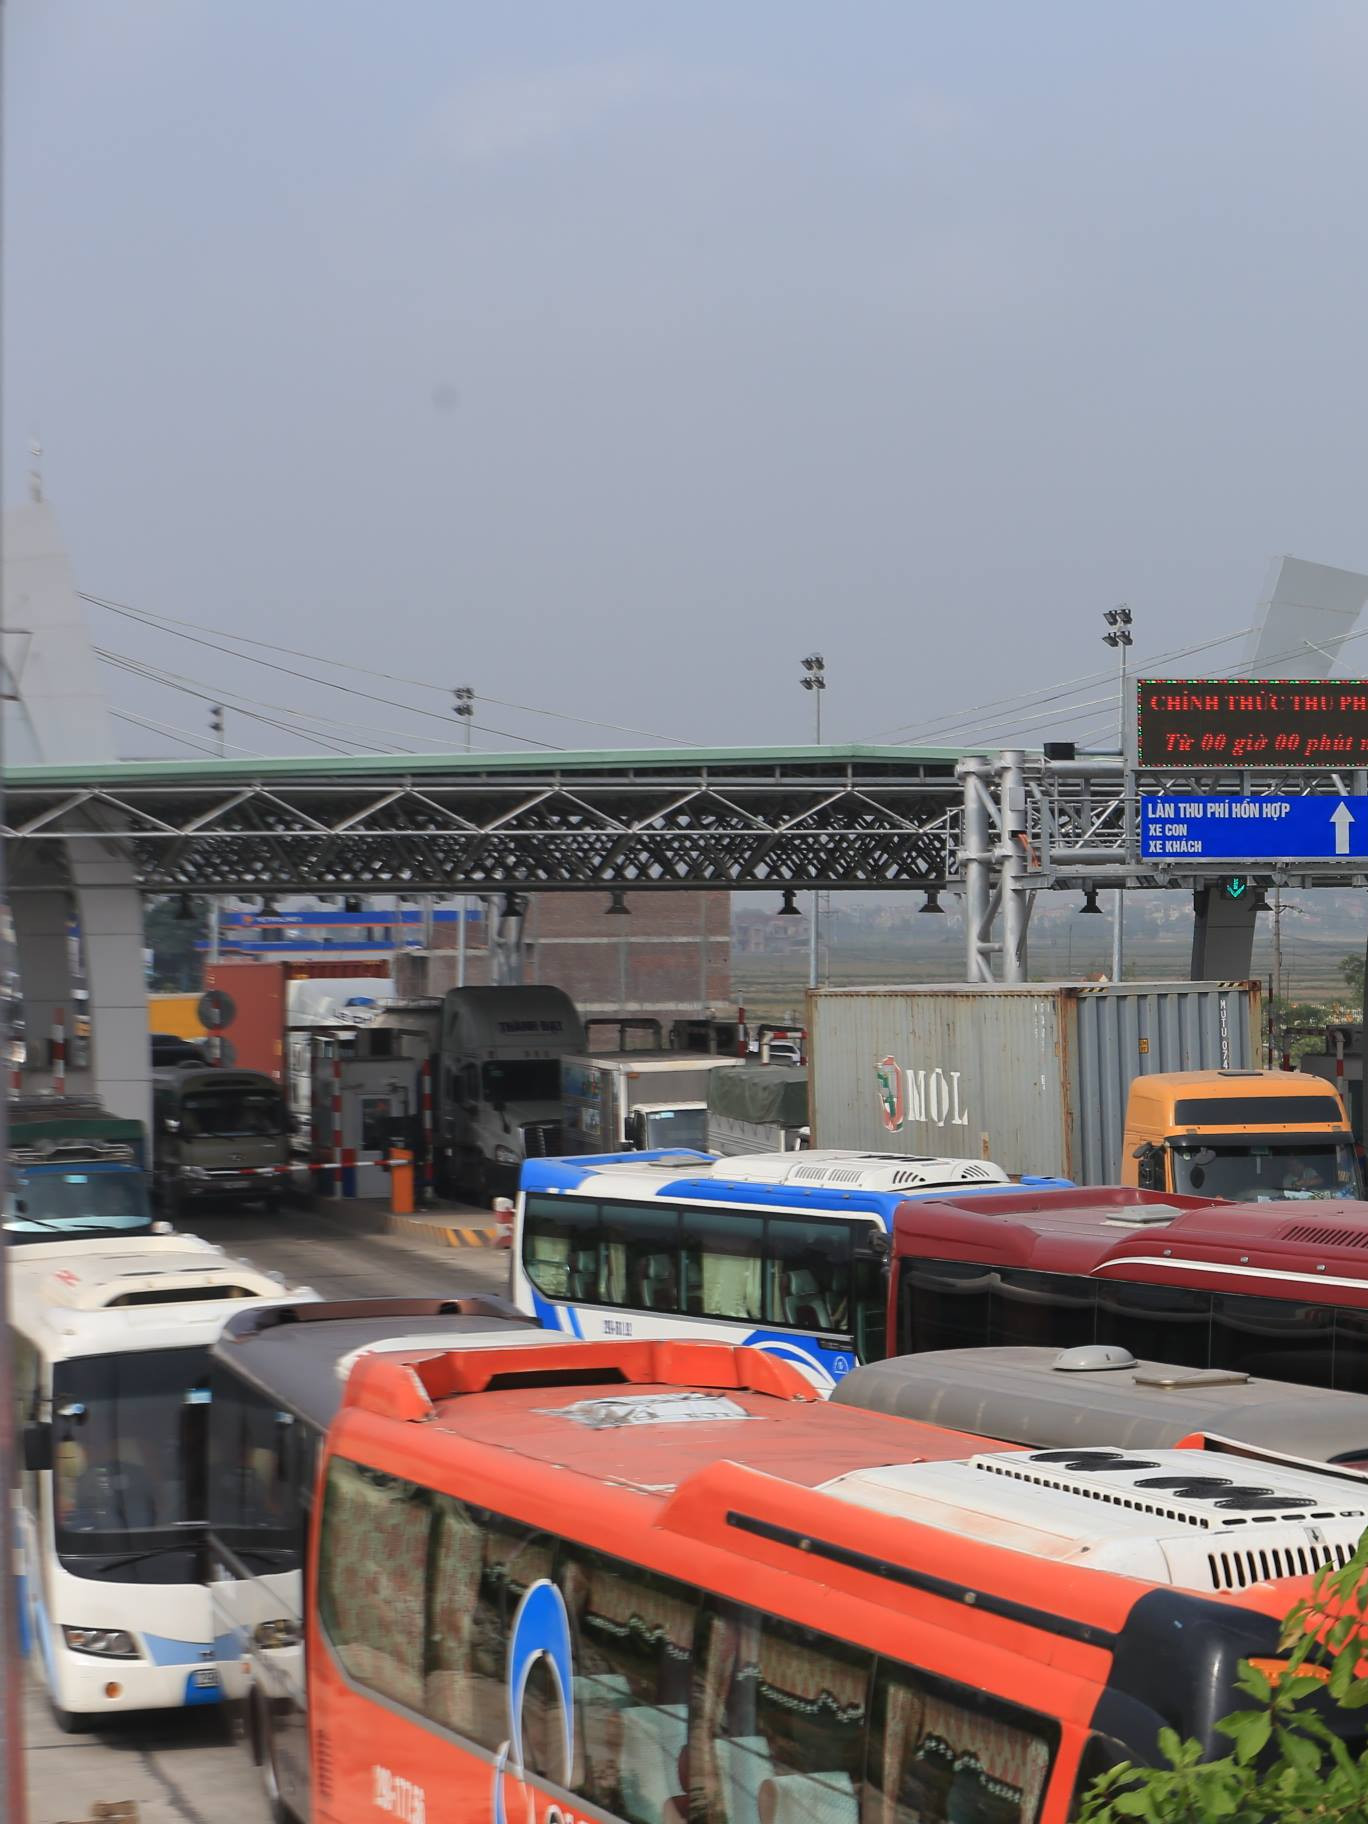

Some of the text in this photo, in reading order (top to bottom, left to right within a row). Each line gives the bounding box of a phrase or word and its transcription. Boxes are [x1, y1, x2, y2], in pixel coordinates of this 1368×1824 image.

[1290, 696, 1334, 711] THU
[1201, 732, 1227, 751] 00
[1275, 732, 1300, 751] 00
[1303, 733, 1354, 756] phút
[1147, 800, 1175, 819] LÀN
[1178, 803, 1203, 818] THU
[1207, 800, 1229, 819] PHÍ
[1262, 802, 1290, 821] HỢP
[1148, 824, 1187, 836] XE CON
[1148, 838, 1202, 853] XE KHÁCH
[906, 1067, 968, 1127] MOL
